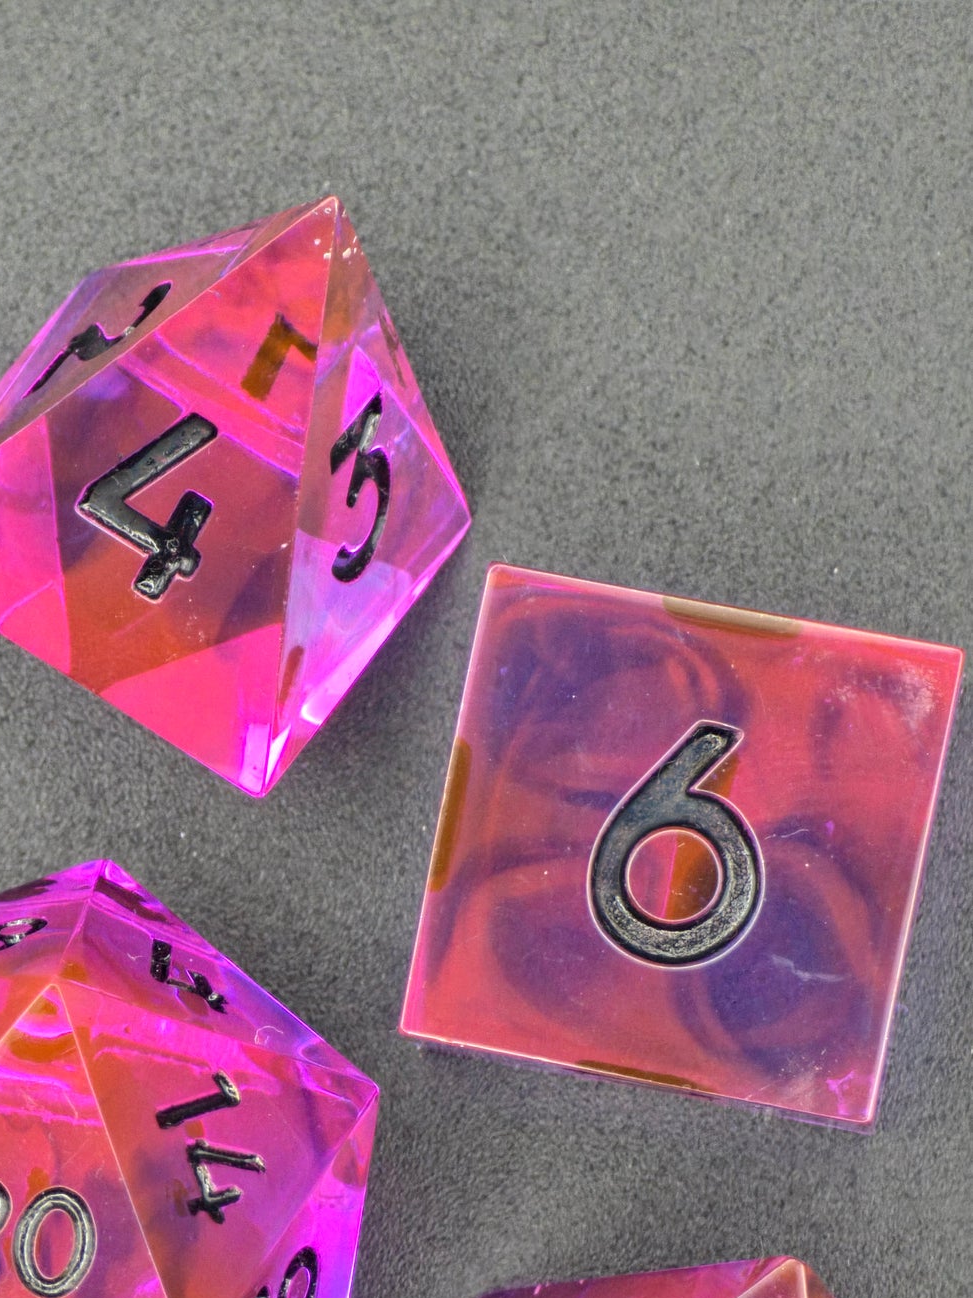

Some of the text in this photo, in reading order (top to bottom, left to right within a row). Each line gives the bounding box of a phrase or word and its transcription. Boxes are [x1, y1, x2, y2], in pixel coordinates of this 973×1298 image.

[75, 412, 219, 603] 4
[588, 720, 765, 970] 6
[156, 1071, 267, 1225] 14
